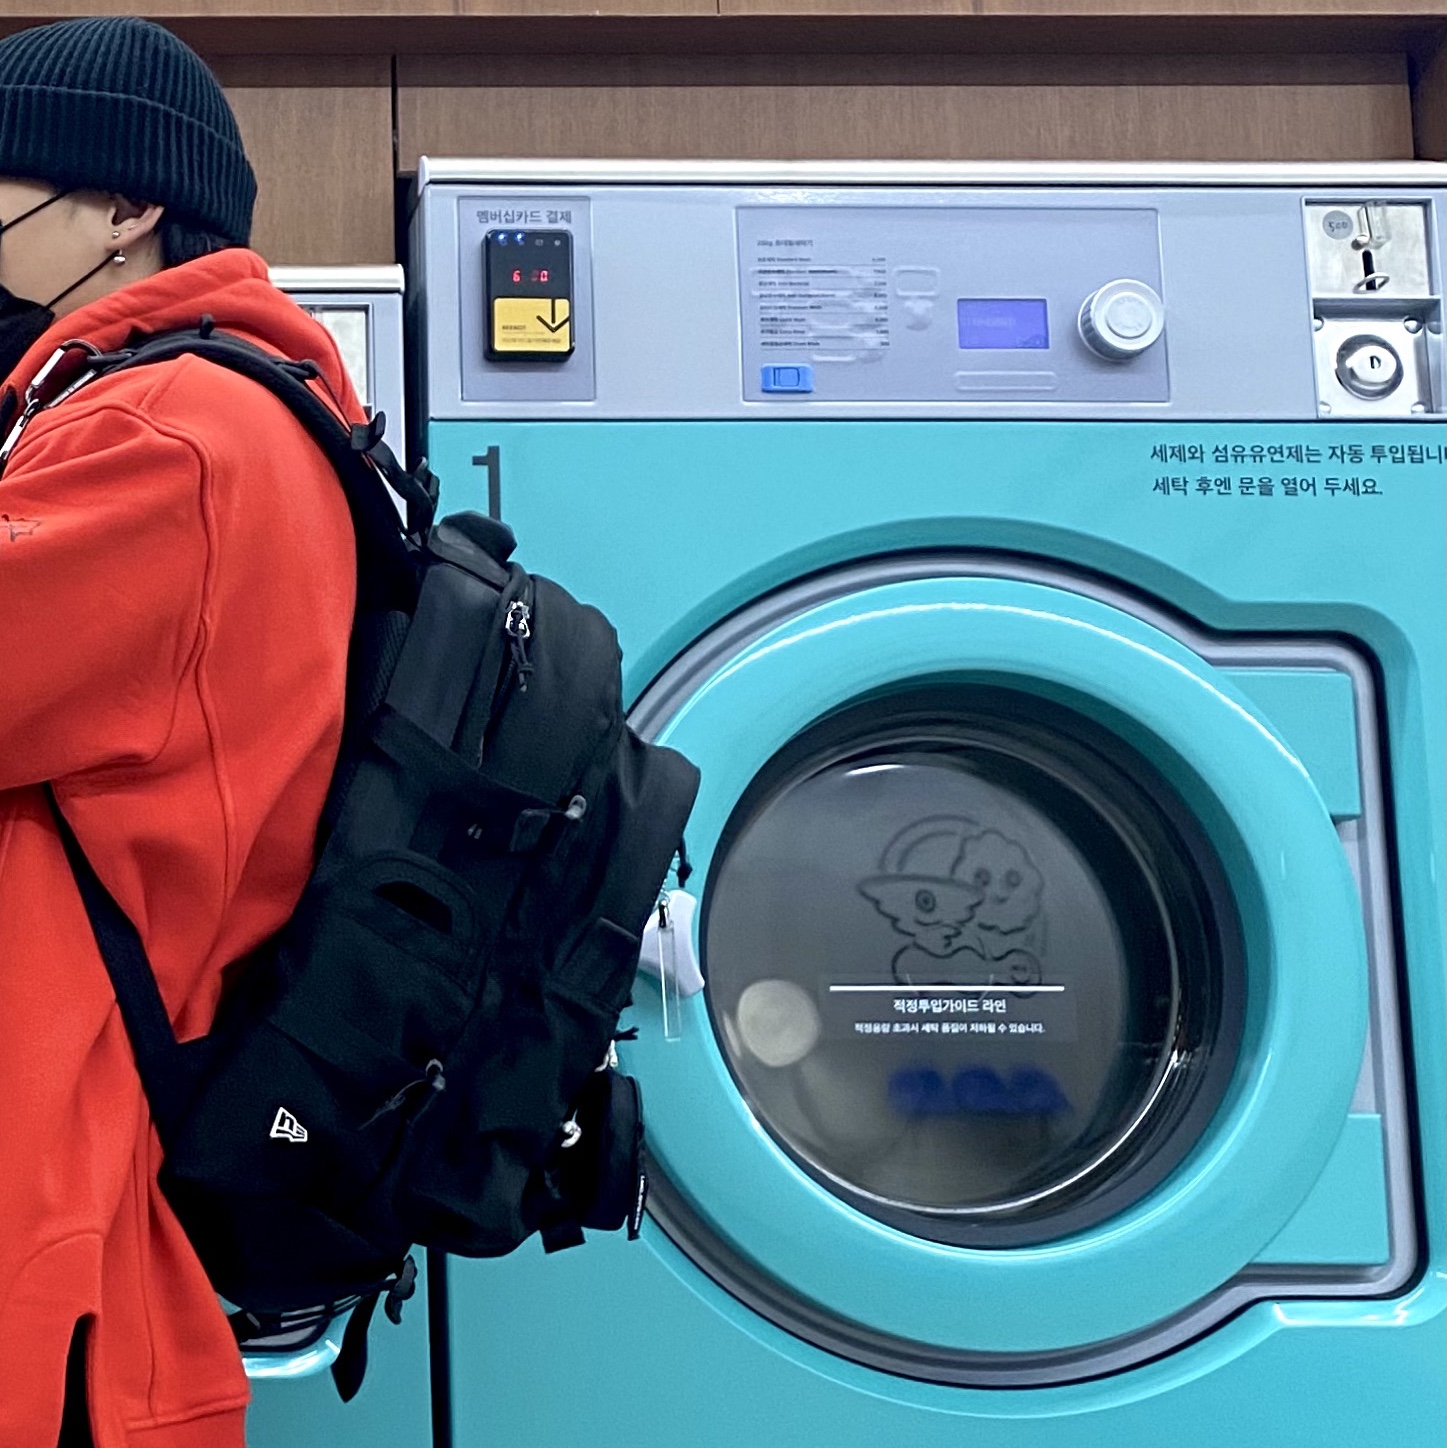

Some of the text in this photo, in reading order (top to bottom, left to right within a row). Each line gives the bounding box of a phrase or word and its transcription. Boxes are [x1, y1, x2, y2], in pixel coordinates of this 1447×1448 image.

[477, 210, 572, 223] 멤버십카드 결제
[1151, 444, 1447, 464] 세제와 섬유유연제는 자동 투입됩니
[472, 445, 501, 520] 1
[1153, 476, 1383, 496] 세탁 후엔 문을 열어 두세요.
[893, 999, 1007, 1013] 적정투입가이드 라인
